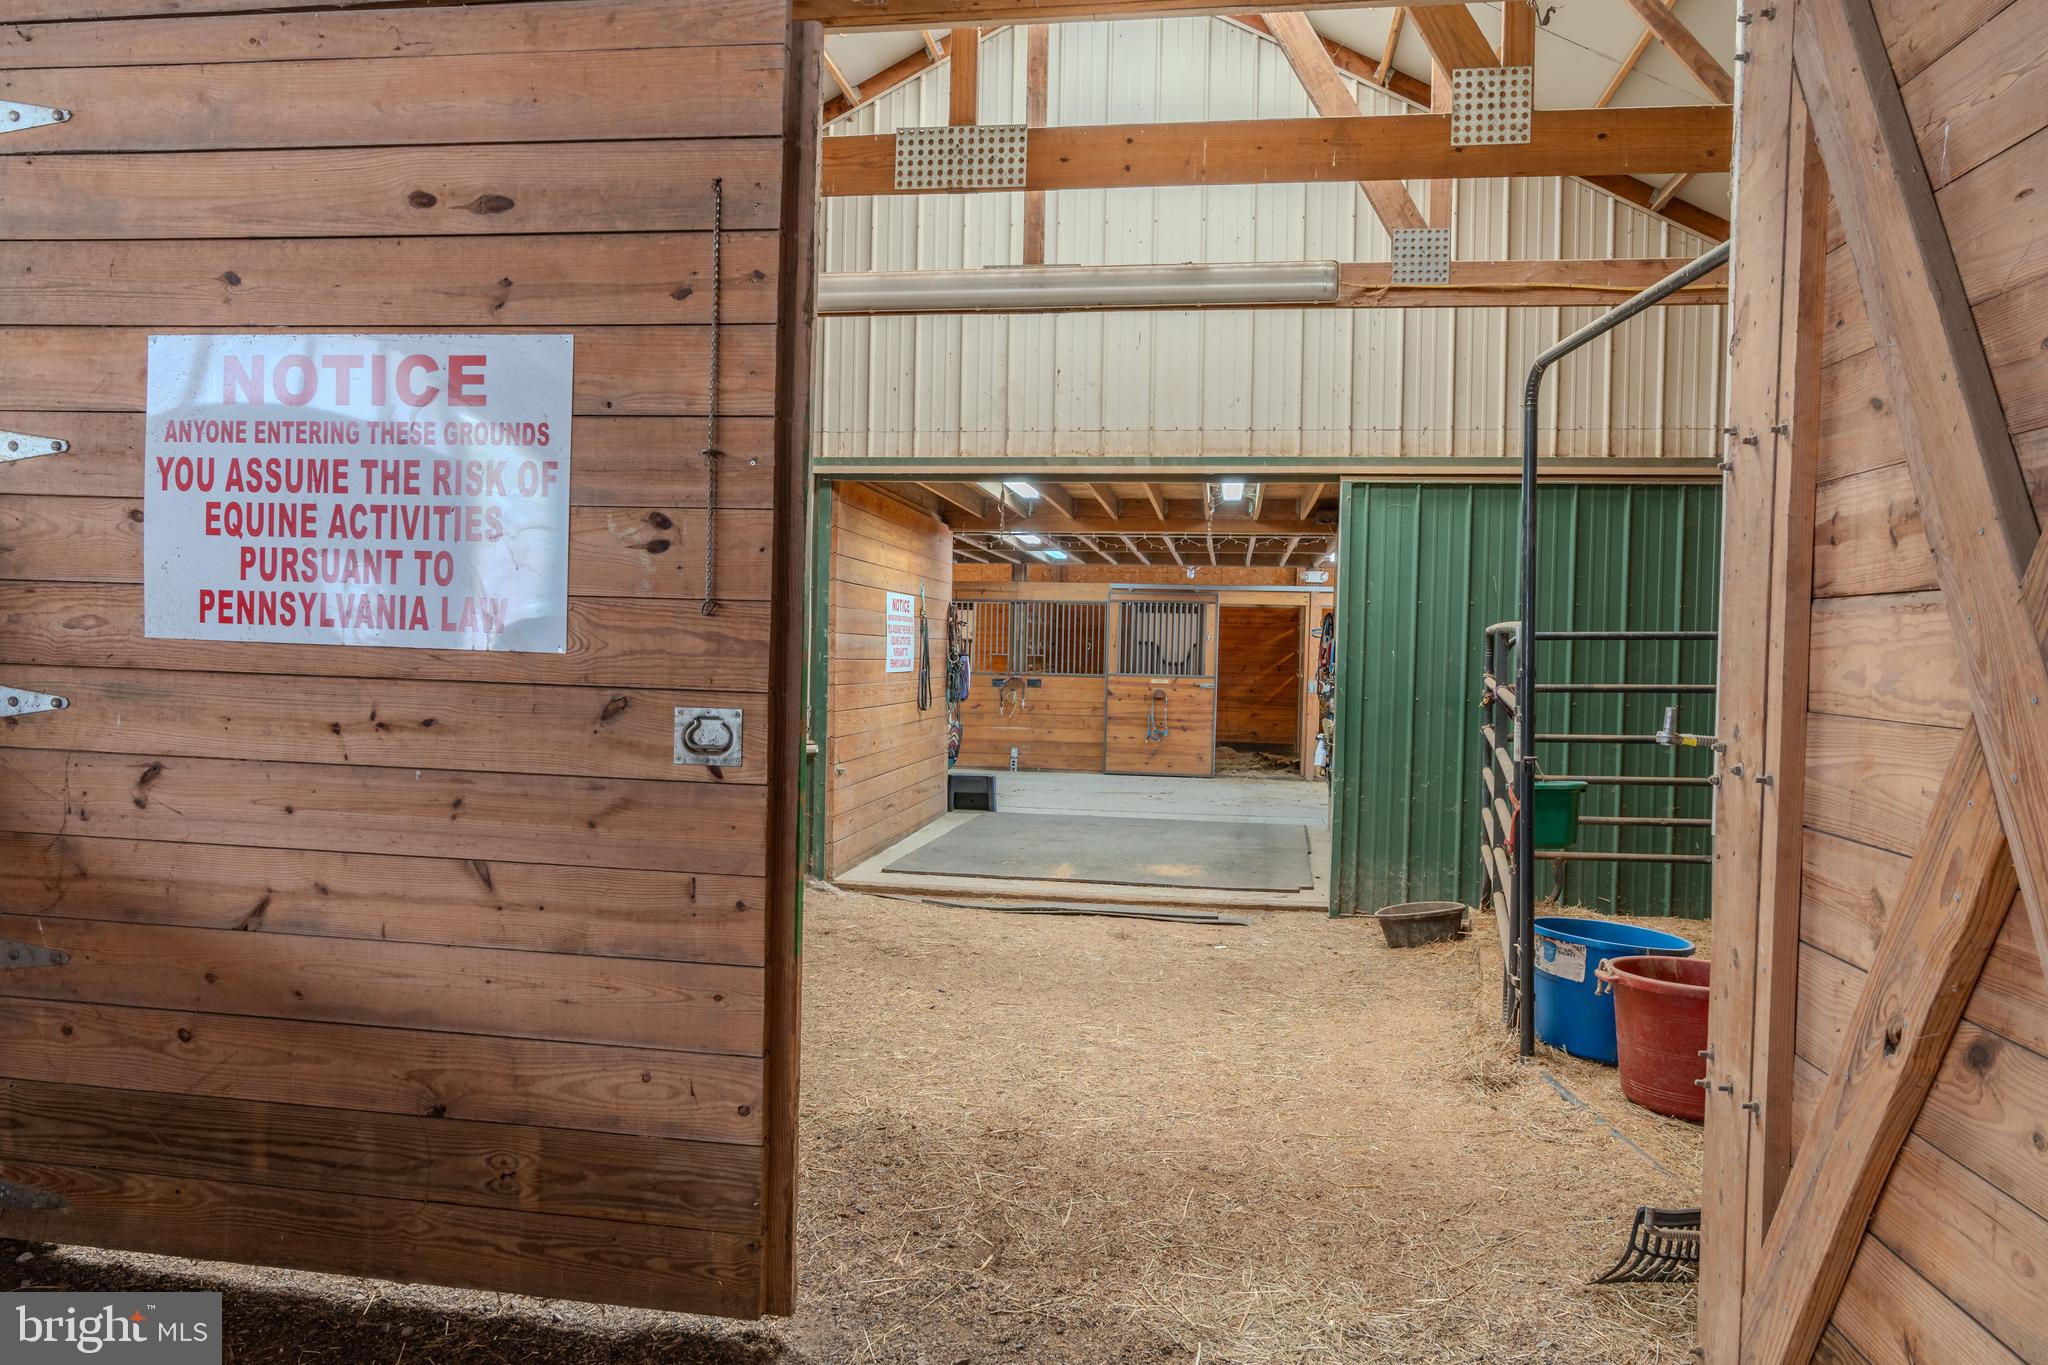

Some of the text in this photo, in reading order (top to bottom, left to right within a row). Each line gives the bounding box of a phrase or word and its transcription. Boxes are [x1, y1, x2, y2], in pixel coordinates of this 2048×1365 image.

[223, 354, 487, 407] NOTICE
[164, 420, 550, 446] ANYONE ENTERING THESE GROUNDS
[157, 456, 559, 498] YOU ASSUME THE RISK OF
[205, 502, 503, 542] EQUINE ACTIVITIES
[240, 546, 454, 586] PURSUANT TO
[200, 589, 508, 634] PENNSYLVANIA LAW
[892, 598, 910, 613] NOTICE
